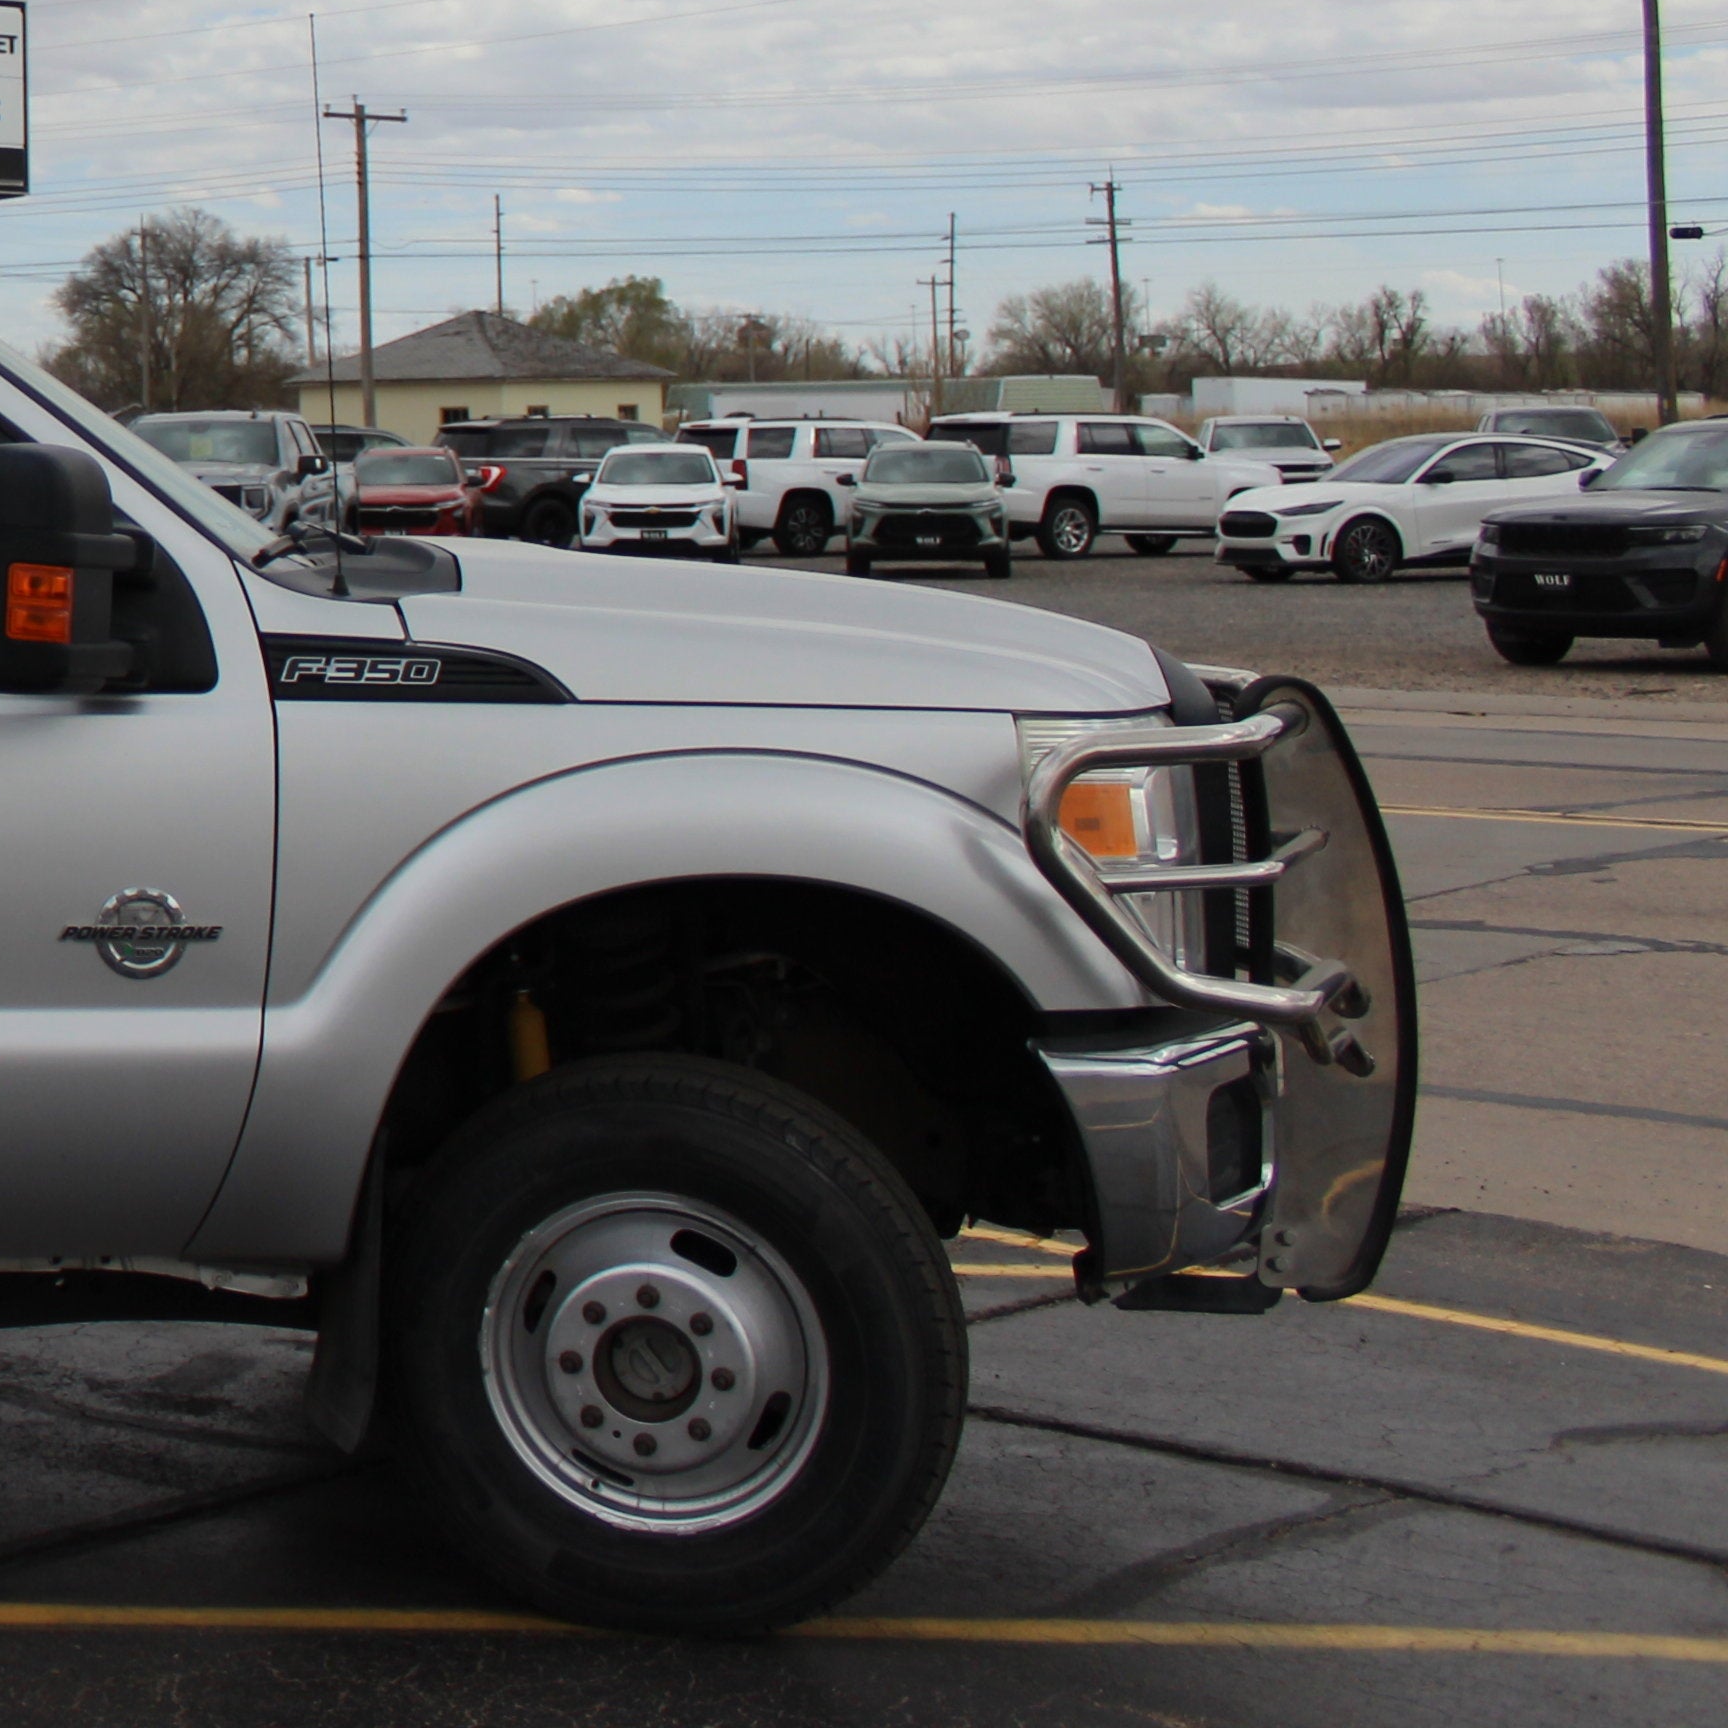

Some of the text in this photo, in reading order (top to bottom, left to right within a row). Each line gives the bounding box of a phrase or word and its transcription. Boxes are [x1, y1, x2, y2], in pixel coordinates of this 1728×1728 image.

[1534, 574, 1569, 586] WOLF
[280, 656, 441, 685] F-350
[60, 926, 223, 940] POWER STROKE
